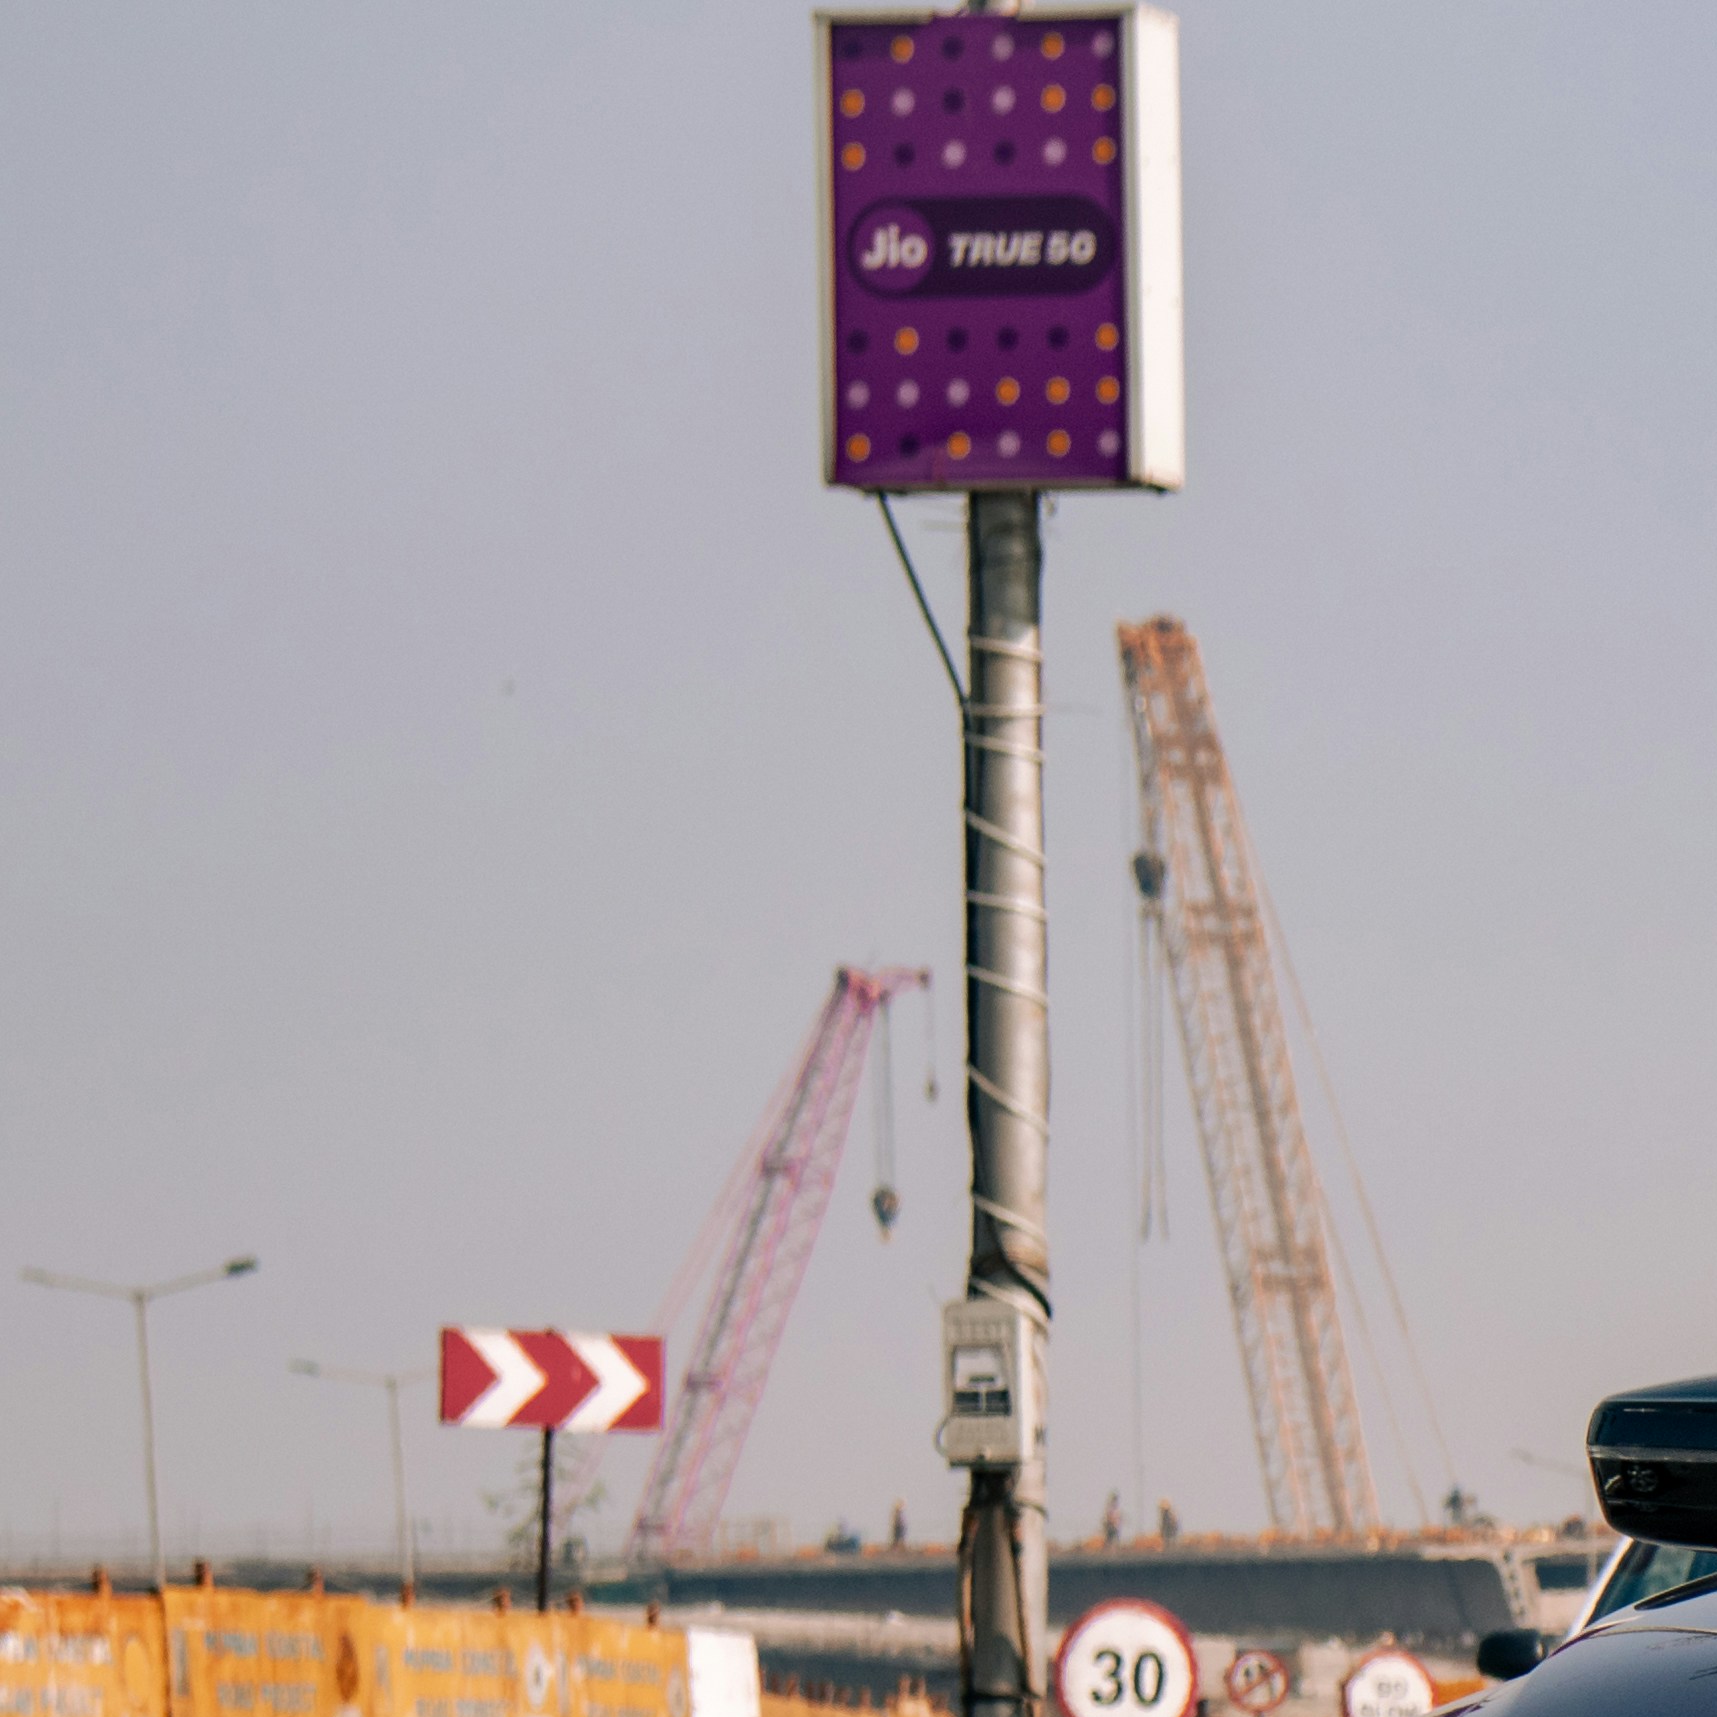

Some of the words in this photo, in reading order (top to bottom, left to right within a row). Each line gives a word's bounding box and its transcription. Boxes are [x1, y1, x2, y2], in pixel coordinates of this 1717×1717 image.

[861, 222, 929, 271] Jio
[948, 230, 1044, 268] TRUE
[1091, 1650, 1167, 1707] 30
